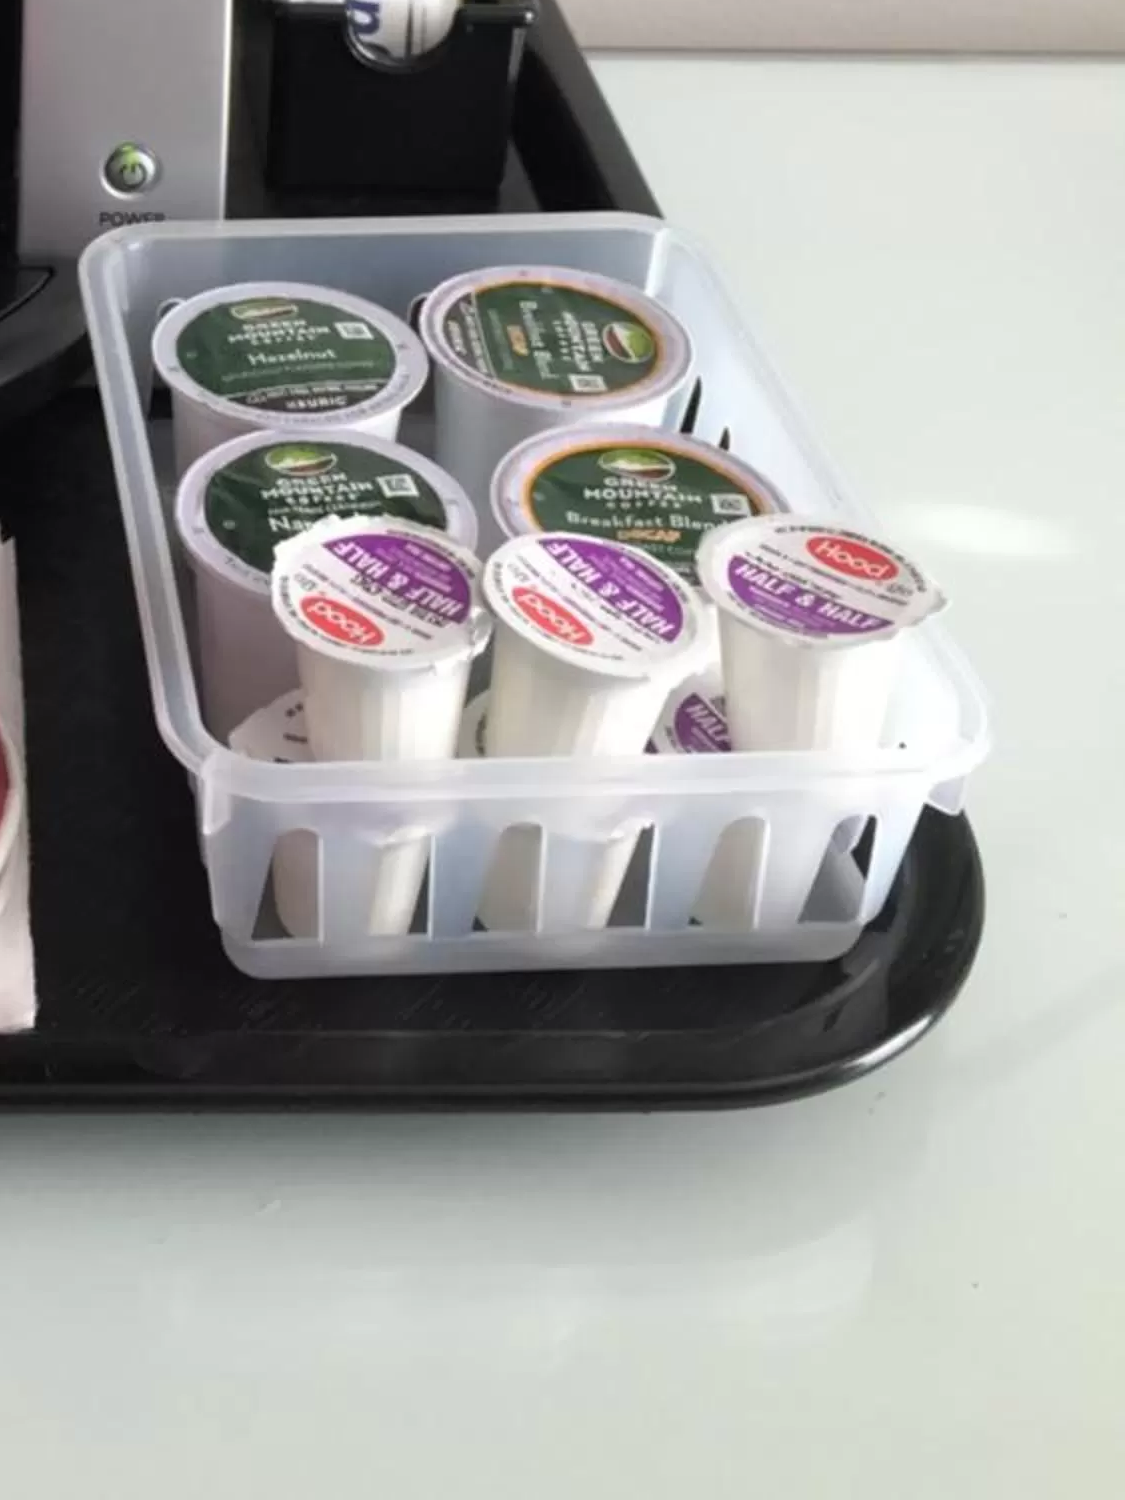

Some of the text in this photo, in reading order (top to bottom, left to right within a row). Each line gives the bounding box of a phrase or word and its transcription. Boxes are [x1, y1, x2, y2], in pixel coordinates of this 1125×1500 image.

[247, 348, 338, 367] Hazelnut
[260, 482, 374, 499] MOUNTAIN
[583, 486, 703, 504] MOUNTAIN
[603, 476, 677, 491] GREEN
[565, 510, 663, 528] Breakfast
[333, 541, 390, 580] HALF
[546, 541, 603, 584] HALF
[813, 539, 891, 579] Hood
[386, 572, 410, 591] &
[599, 581, 621, 598] &
[735, 562, 796, 596] HALF
[794, 592, 817, 608] &
[817, 599, 883, 629] HALF
[404, 585, 465, 617] HALF
[518, 591, 586, 642] Hood
[615, 597, 675, 636] HALF
[306, 601, 376, 644] Hood
